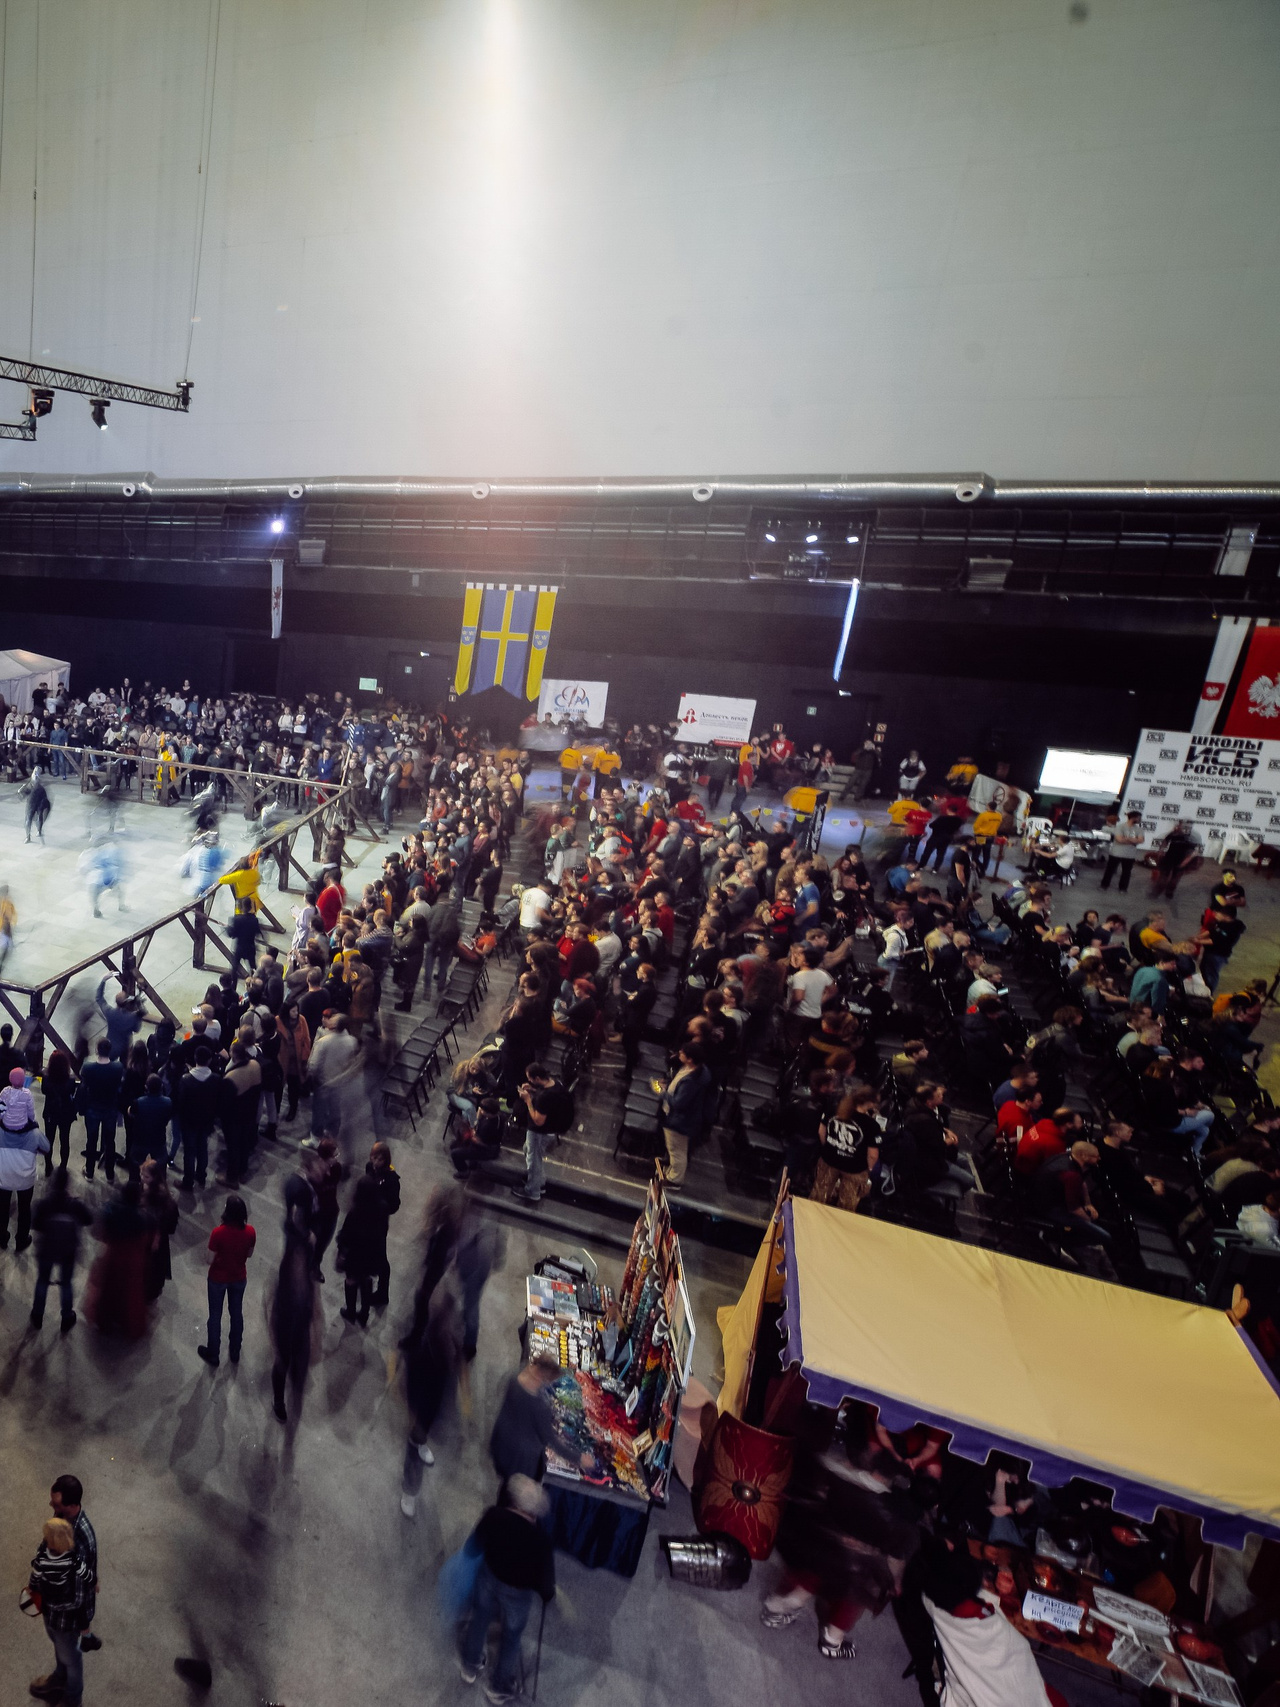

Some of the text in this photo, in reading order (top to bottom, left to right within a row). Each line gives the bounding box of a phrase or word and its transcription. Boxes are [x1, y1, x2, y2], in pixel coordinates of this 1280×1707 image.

[1191, 735, 1263, 750] ШКОЛЫ
[1185, 745, 1260, 769] ИСБ
[1182, 763, 1255, 779] РОССИИ
